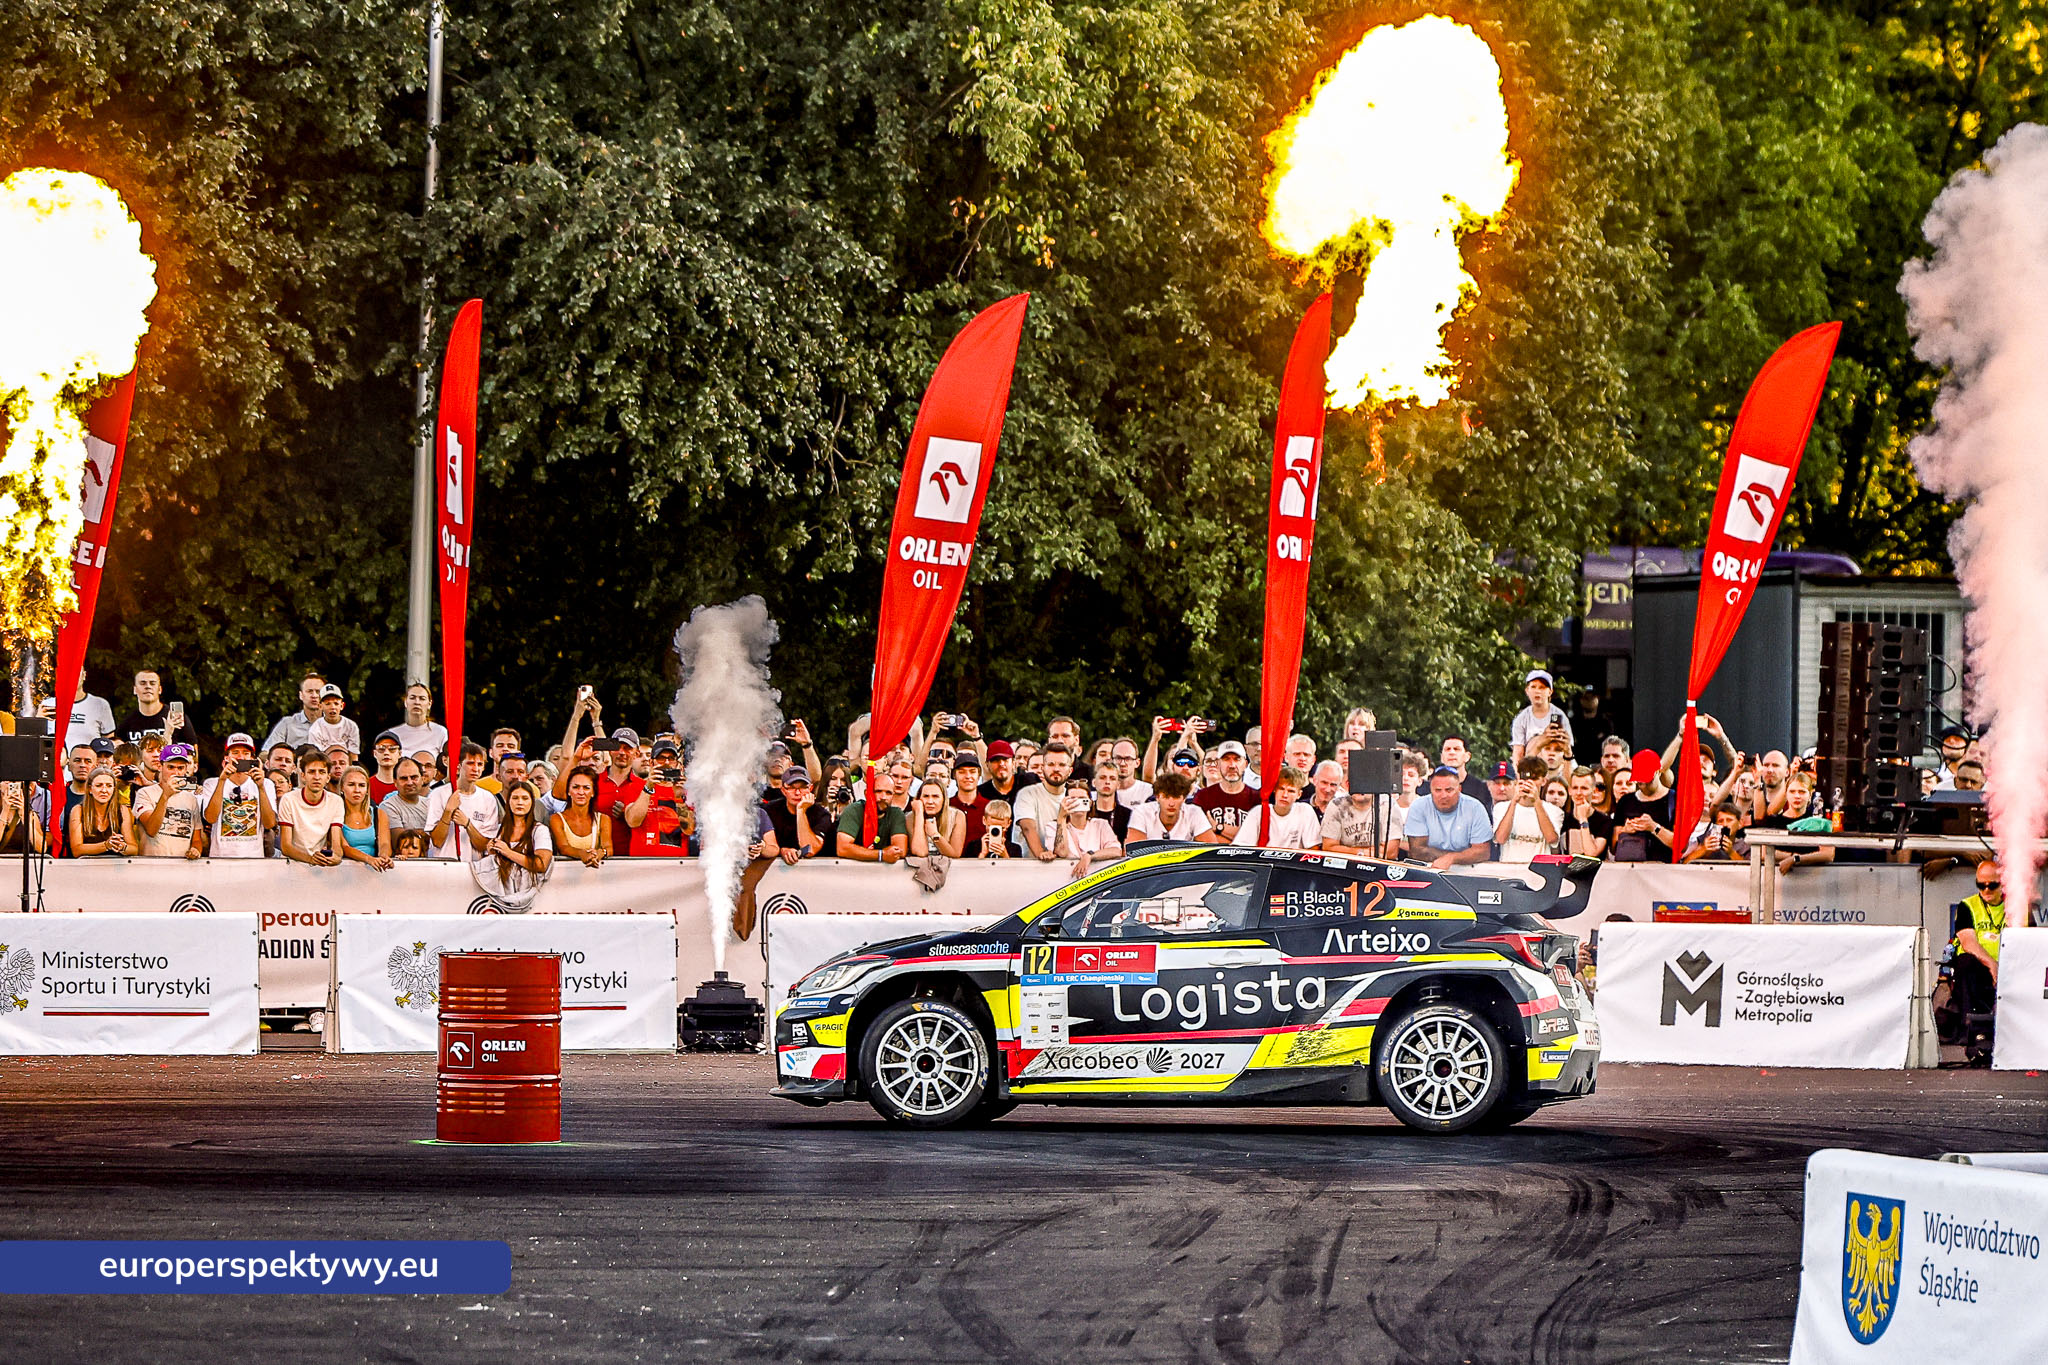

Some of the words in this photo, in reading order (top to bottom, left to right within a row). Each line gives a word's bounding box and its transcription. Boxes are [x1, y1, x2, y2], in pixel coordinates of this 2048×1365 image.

[899, 535, 972, 567] ORLEN
[912, 569, 943, 591] OIL
[1356, 863, 1377, 872] mor
[1286, 891, 1346, 905] R.Blach
[1345, 881, 1386, 917] 12
[1286, 904, 1345, 918] D.Sosa
[929, 941, 1009, 957] sibuscascoche
[1321, 926, 1431, 954] Arteixo
[42, 951, 168, 970] Ministerstwo
[1027, 946, 1052, 975] 12
[1105, 951, 1139, 960] ORLEN
[41, 977, 106, 998] Sportu
[112, 977, 117, 994] i
[122, 977, 211, 998] Turystyki
[564, 970, 627, 993] rystyki
[1053, 975, 1065, 983] FIA
[1066, 974, 1079, 982] ERC
[1080, 974, 1125, 983] Championship
[1737, 971, 1824, 990] Górnośląsko
[1736, 988, 1845, 1008] -Zagłębiowska
[1734, 1007, 1813, 1025] Metropolia
[481, 1040, 526, 1051] ORLEN
[481, 1053, 499, 1063] OIL
[1044, 1051, 1139, 1070] Xacobeo
[1180, 1052, 1225, 1070] 2027
[1923, 1210, 2040, 1260] Województwo
[1918, 1257, 1979, 1307] Śląskie
